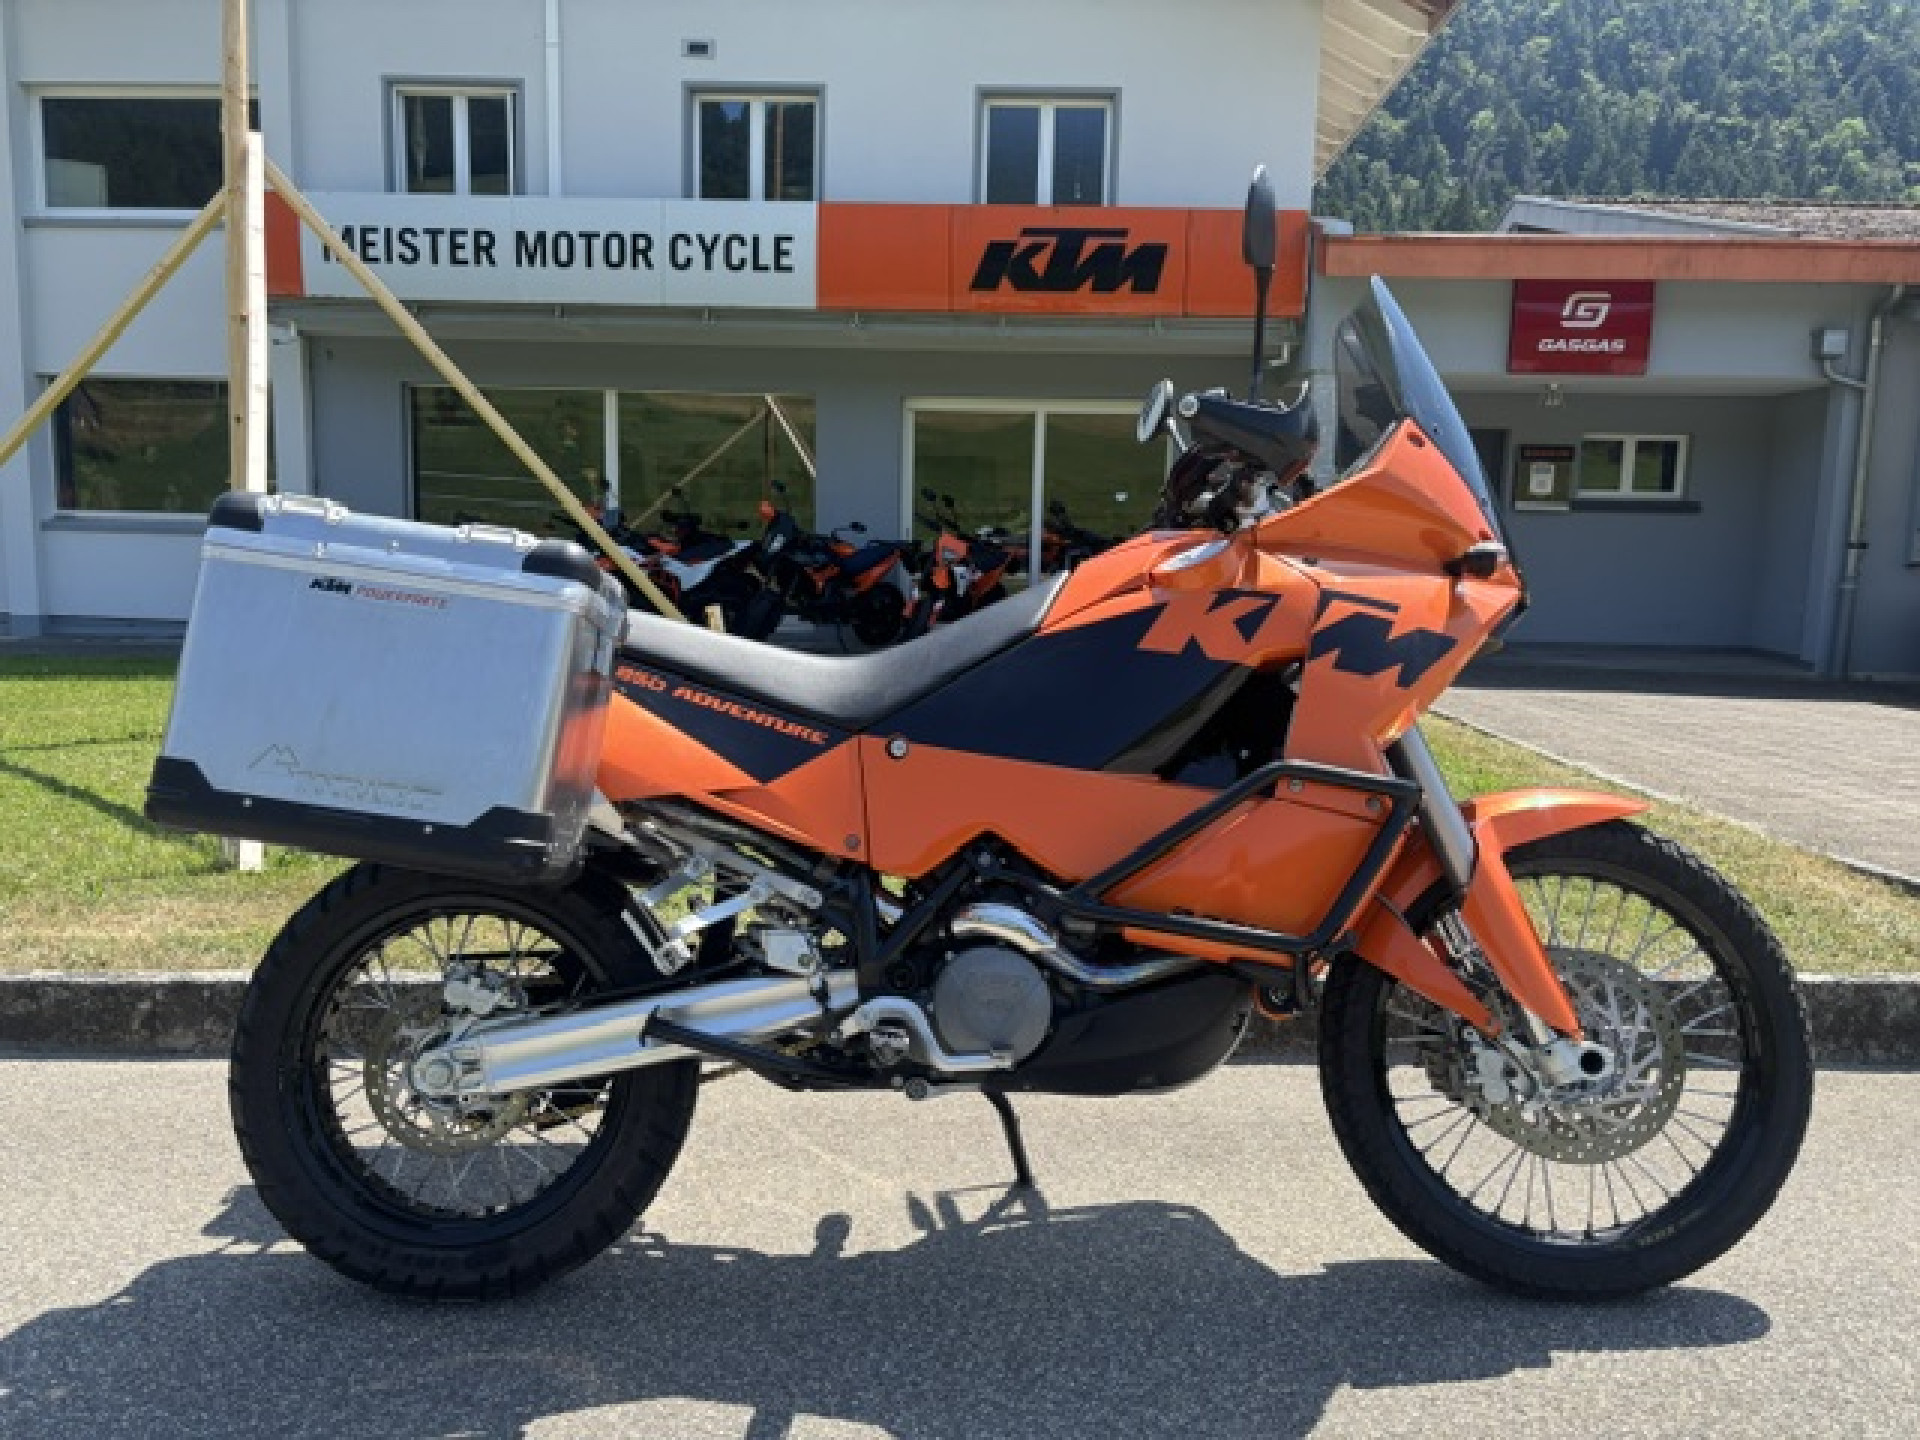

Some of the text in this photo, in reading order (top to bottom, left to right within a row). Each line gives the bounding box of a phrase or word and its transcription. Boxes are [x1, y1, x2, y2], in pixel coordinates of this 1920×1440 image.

[516, 231, 654, 270] MOTOR
[669, 234, 794, 274] CYCLE
[968, 227, 1168, 294] KTM
[1538, 338, 1627, 354] GASGAS
[308, 576, 353, 595] KTM
[1136, 587, 1458, 689] KTM
[671, 686, 830, 745] ADVENTURE
